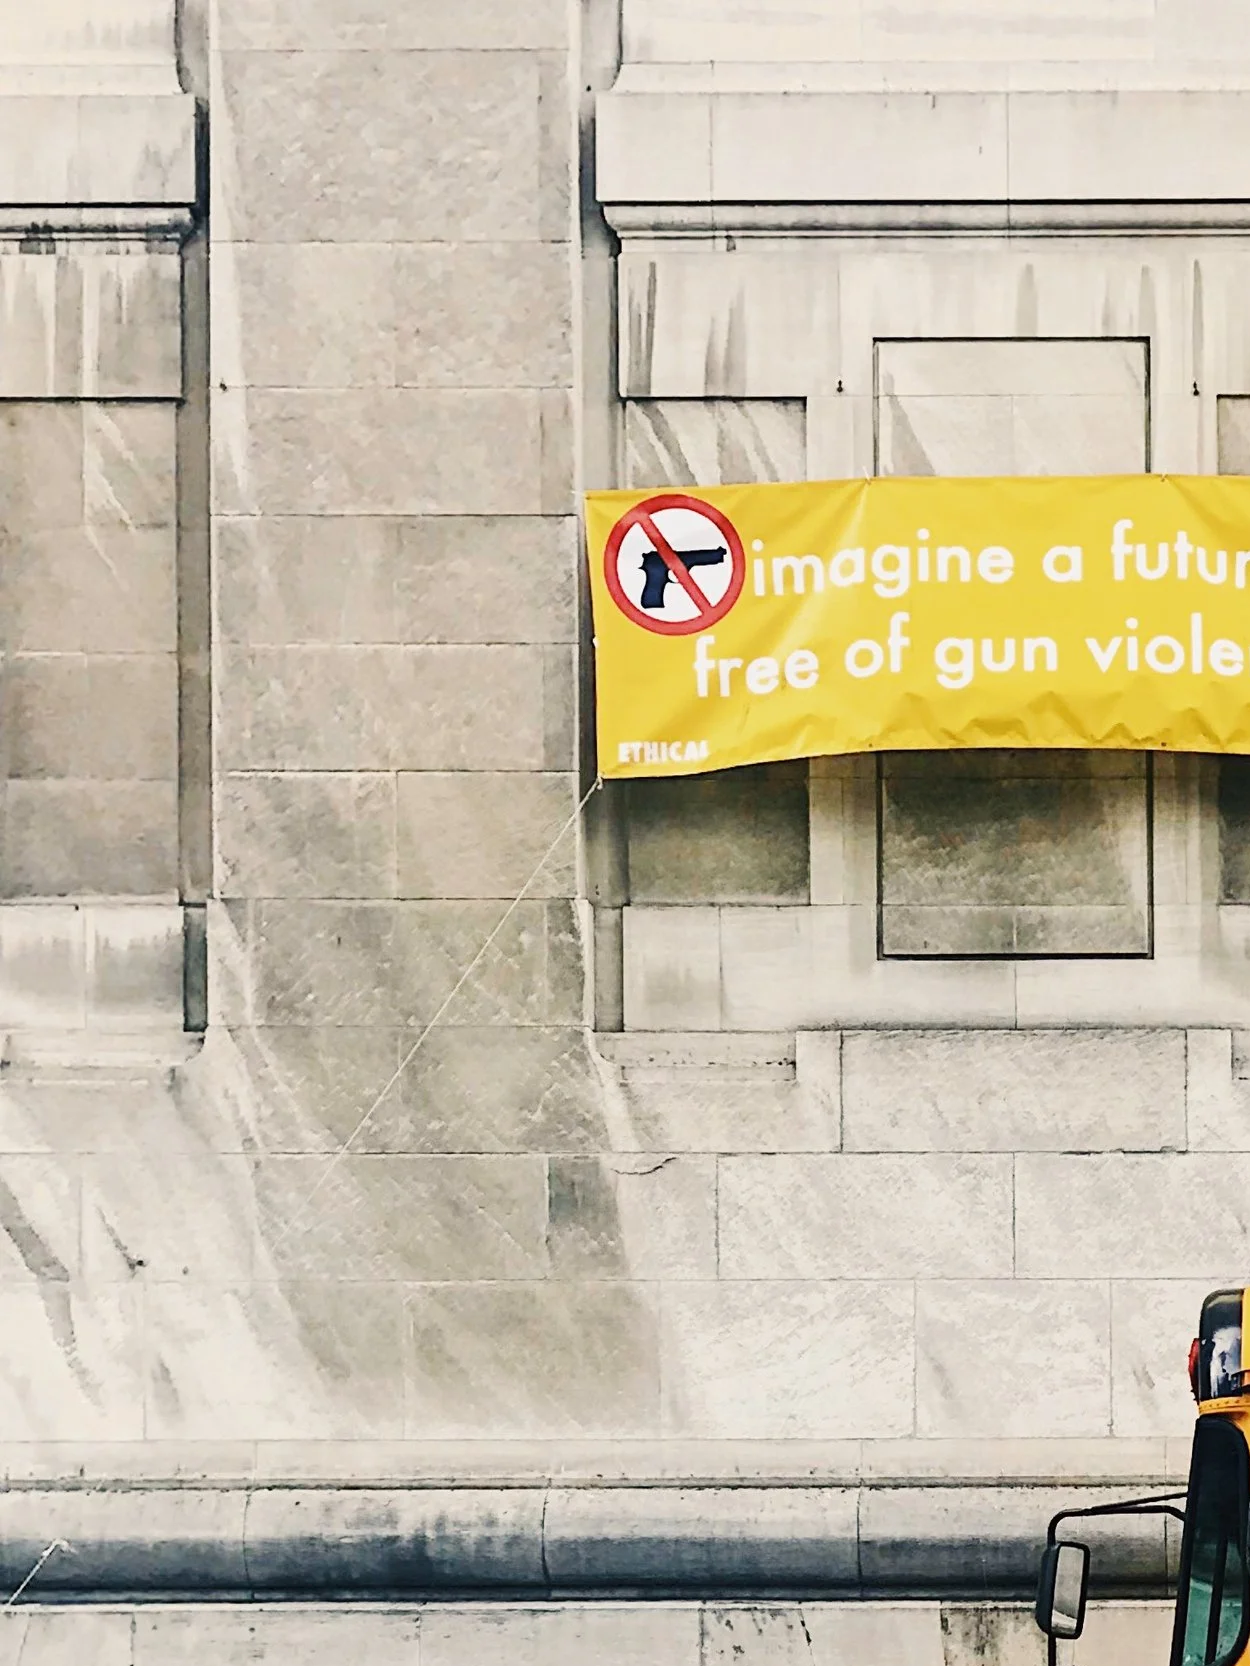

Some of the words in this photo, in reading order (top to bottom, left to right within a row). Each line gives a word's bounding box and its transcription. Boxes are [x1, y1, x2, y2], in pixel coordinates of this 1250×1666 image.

[751, 528, 1014, 598] imagine
[1042, 546, 1082, 582] a
[693, 635, 819, 697] free
[844, 611, 910, 678] of
[934, 636, 1058, 689] gun
